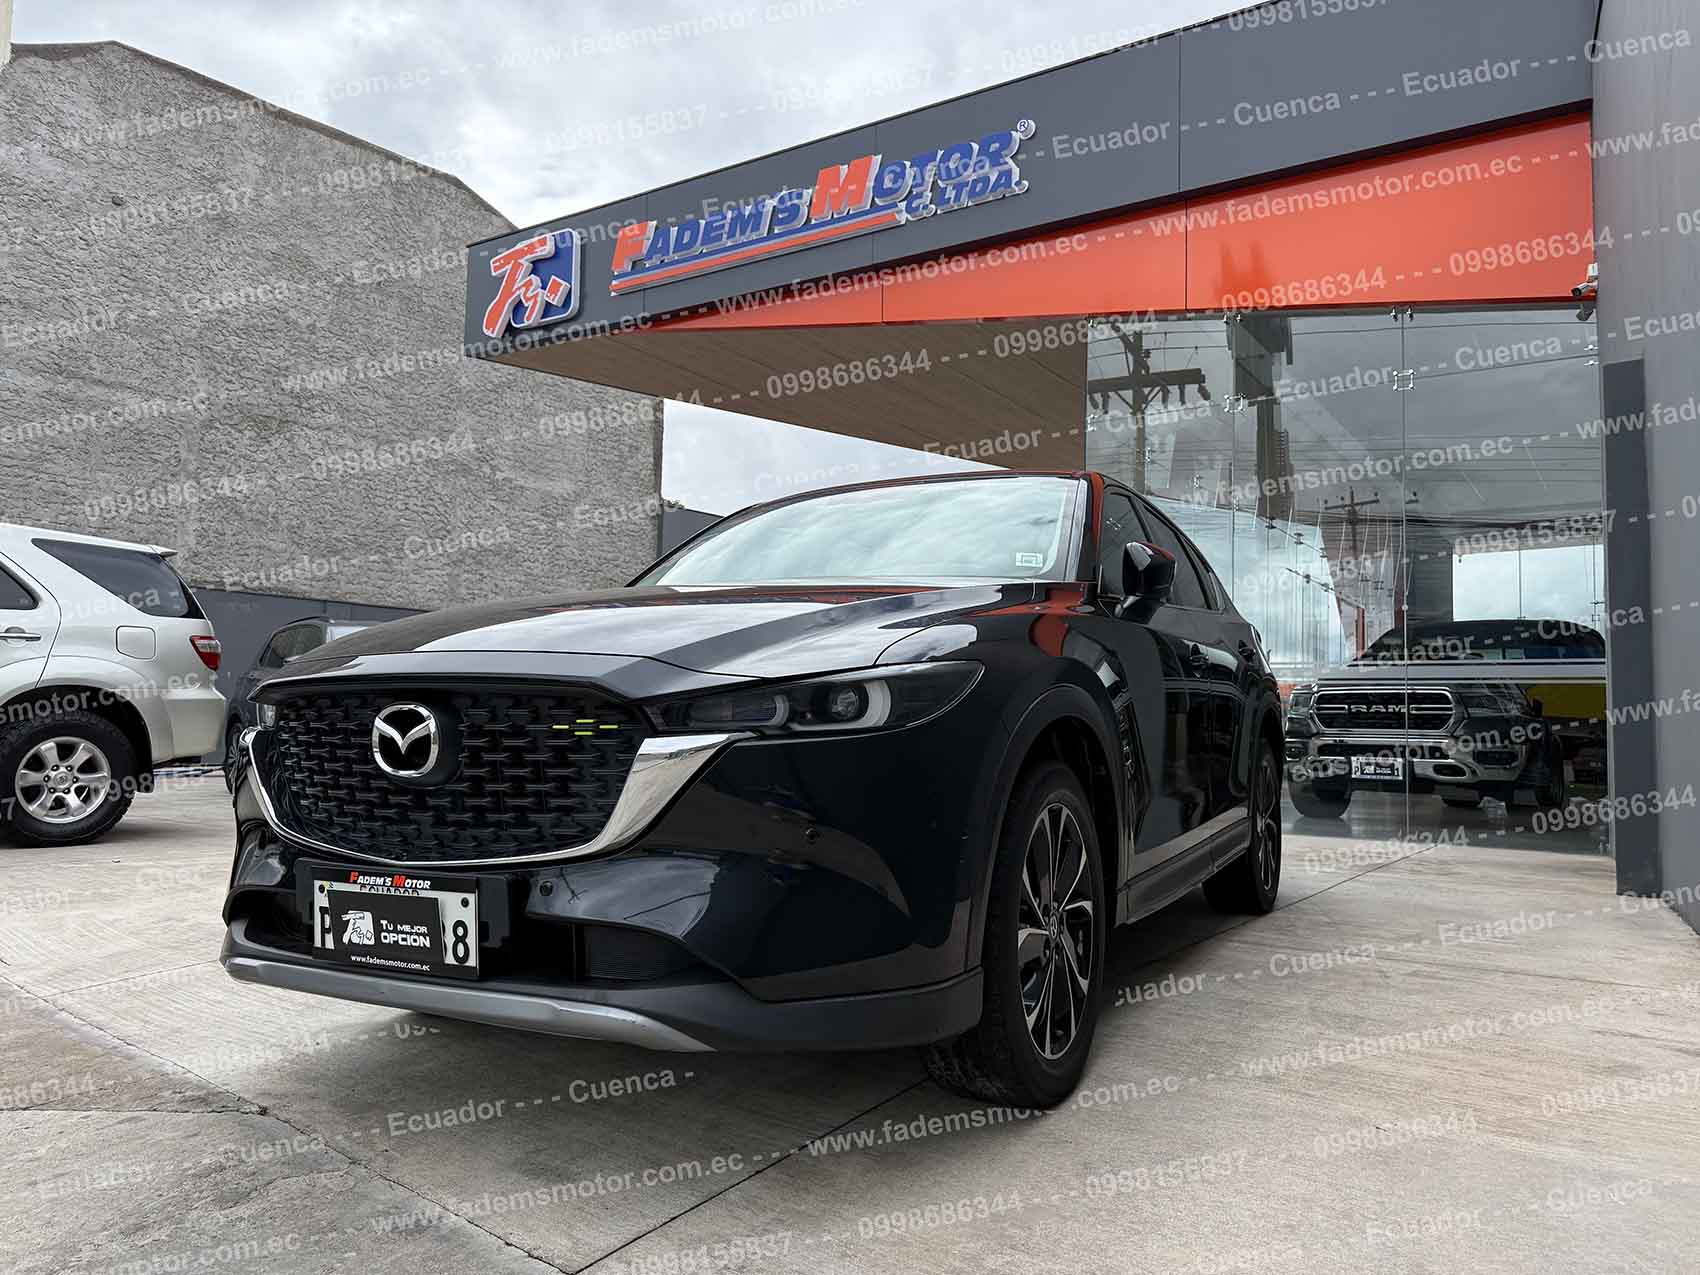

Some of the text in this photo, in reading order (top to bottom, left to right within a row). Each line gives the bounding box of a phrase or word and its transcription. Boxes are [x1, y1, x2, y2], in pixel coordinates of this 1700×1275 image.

[1350, 704, 1407, 713] RAM
[392, 874, 431, 889] MOTOR
[397, 924, 428, 934] MEJOR
[381, 932, 431, 948] OPCIÓN
[351, 954, 430, 972] www.fademsmotor.com.ec
